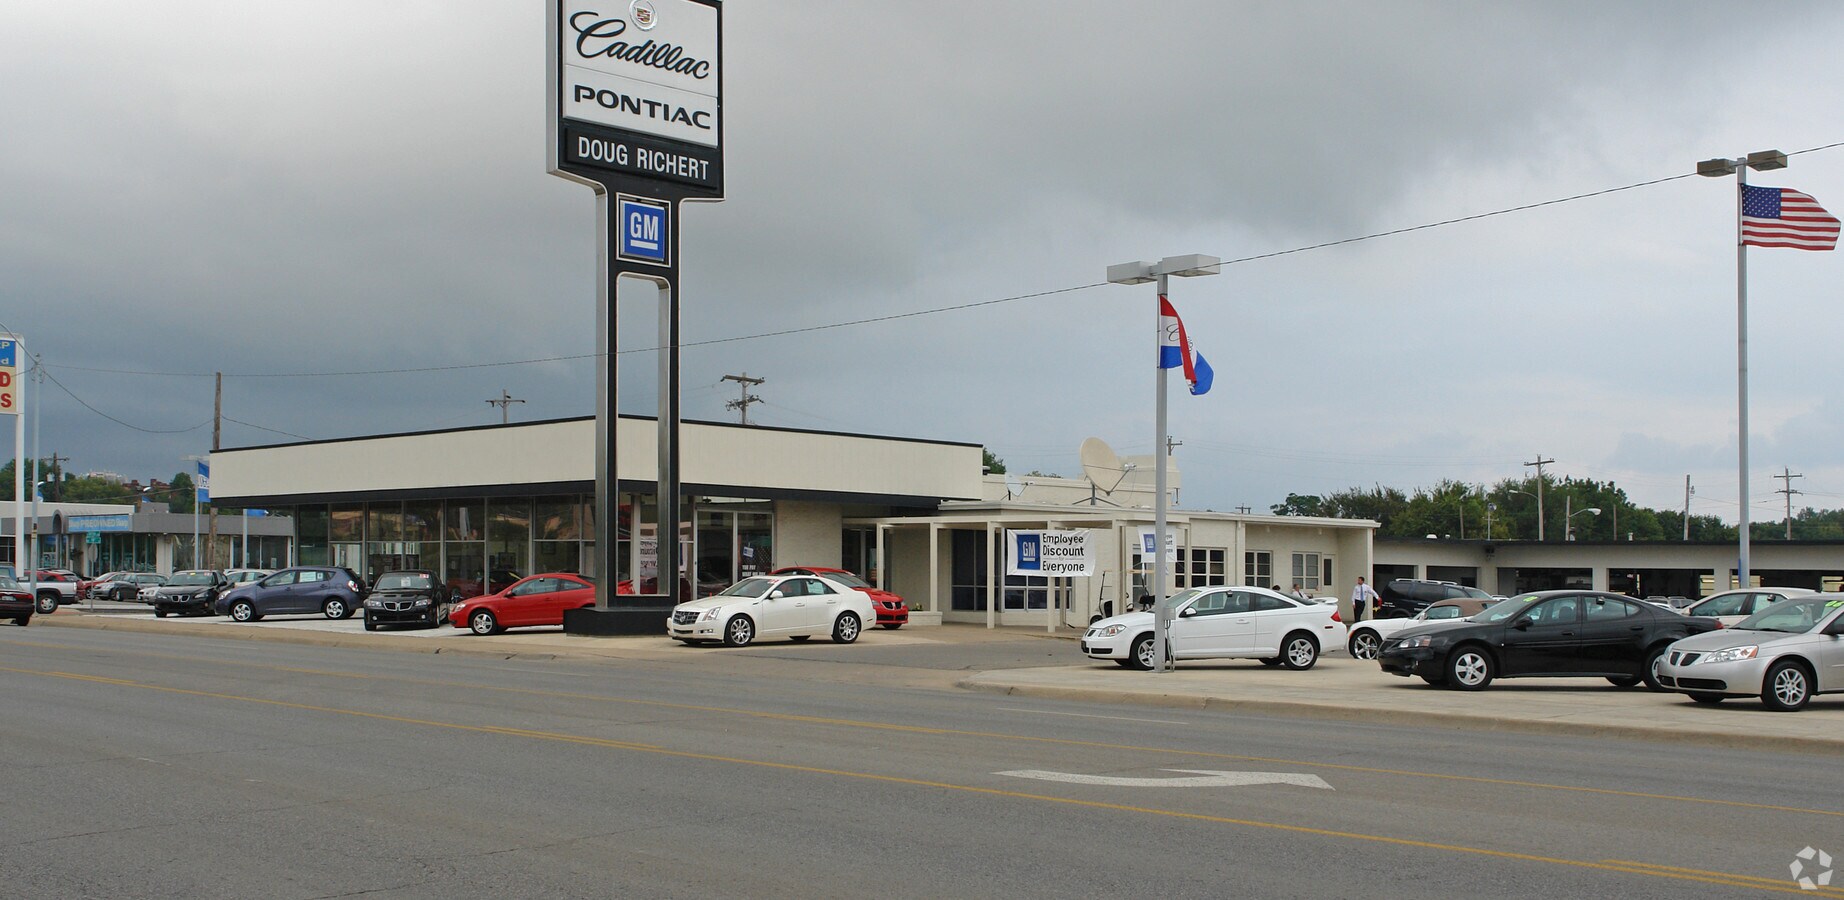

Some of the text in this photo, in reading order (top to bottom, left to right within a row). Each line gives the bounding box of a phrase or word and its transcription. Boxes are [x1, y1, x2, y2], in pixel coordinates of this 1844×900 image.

[569, 11, 709, 79] Cadillac
[574, 84, 711, 130] PONTIAC
[578, 136, 709, 181] DOUG RICHERT
[630, 212, 659, 242] GM
[1023, 542, 1035, 556] GM
[1043, 533, 1084, 545] Employee
[1043, 545, 1085, 556] Discount
[1043, 560, 1085, 573] Everyone
